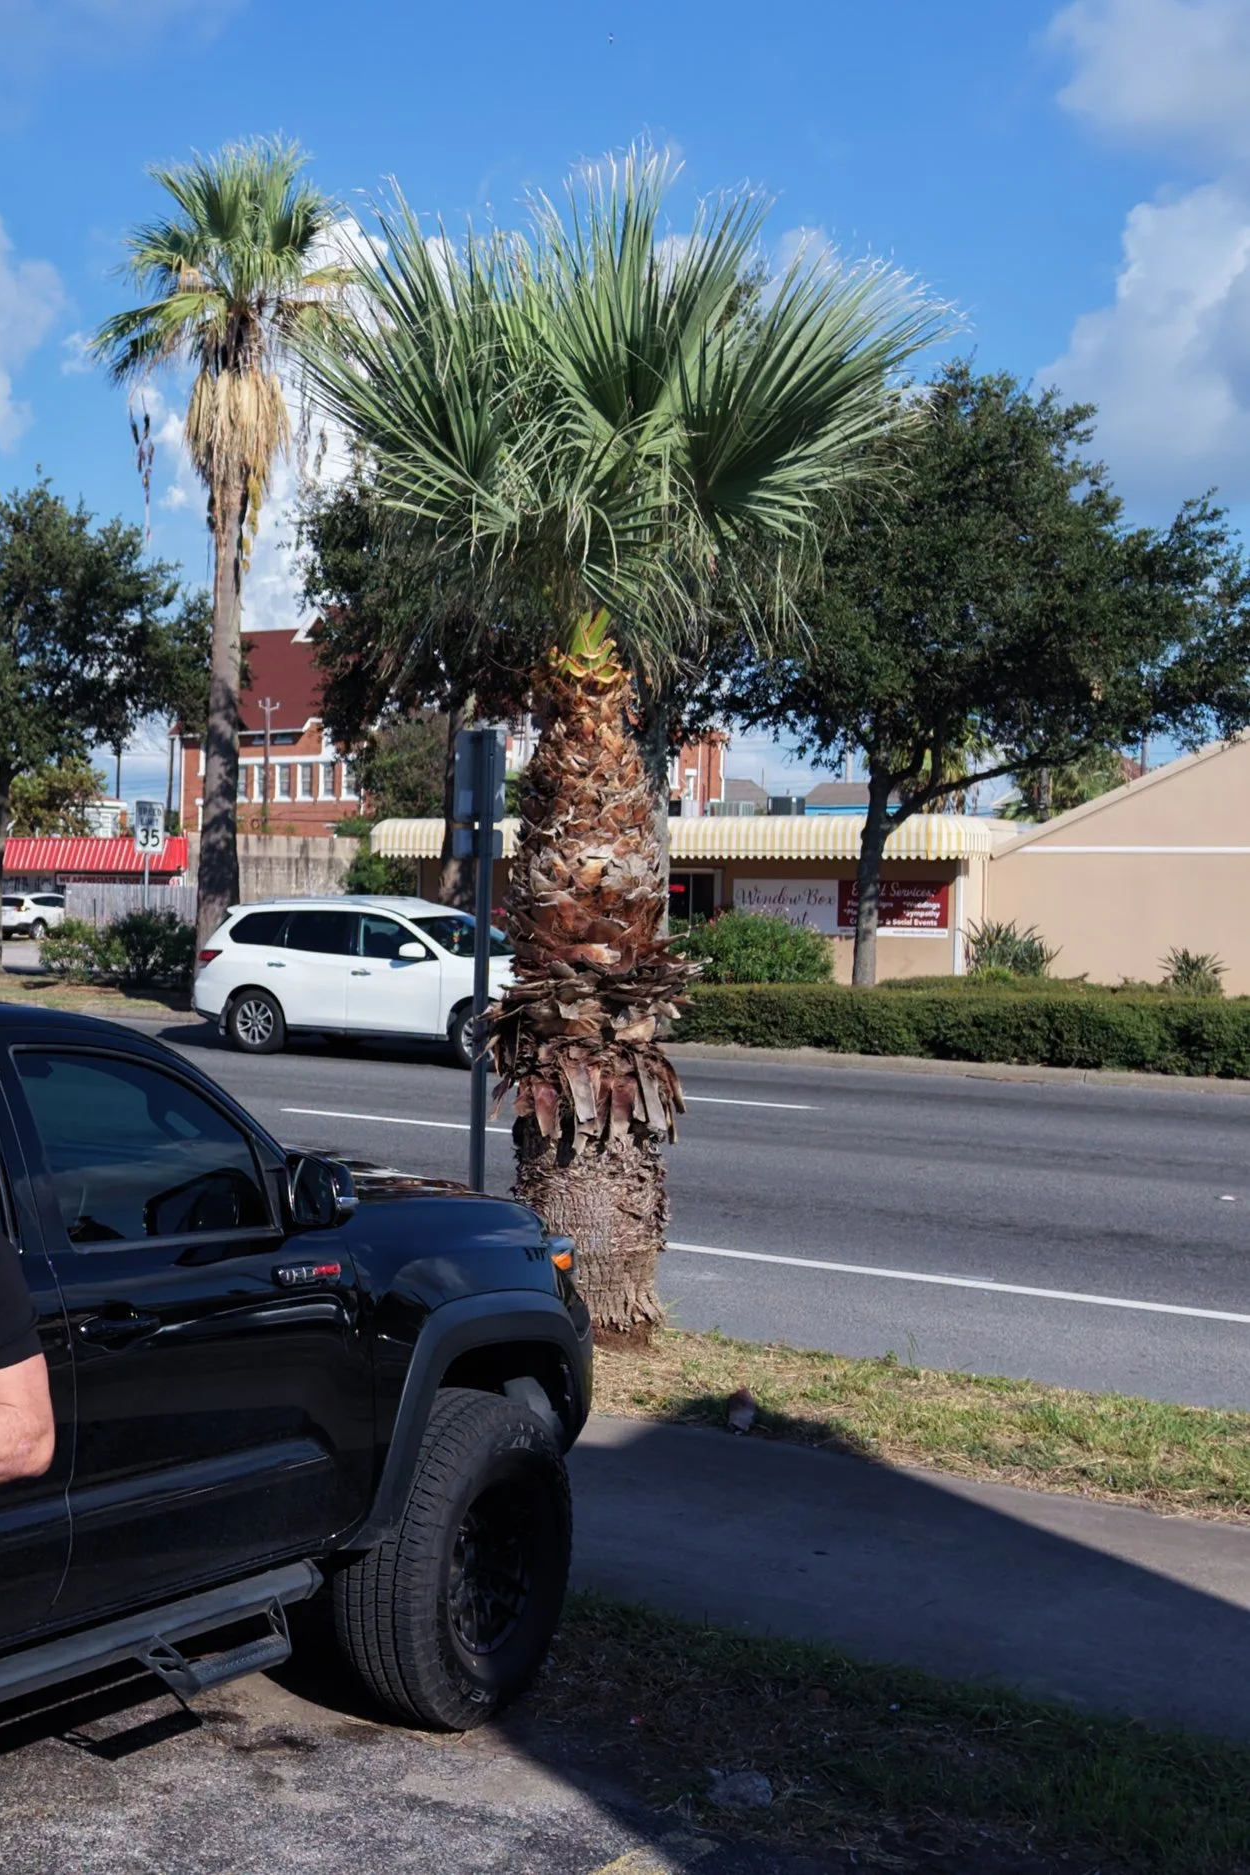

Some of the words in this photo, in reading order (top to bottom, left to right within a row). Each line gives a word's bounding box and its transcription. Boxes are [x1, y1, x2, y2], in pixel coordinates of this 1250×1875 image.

[139, 806, 162, 816] SPEED
[139, 828, 160, 847] 35
[59, 876, 70, 884] WE
[72, 876, 116, 884] APPRECIATE
[119, 876, 142, 884] YOUR
[735, 884, 802, 906] Window
[803, 888, 836, 907] Box
[889, 882, 936, 898] Services:
[892, 918, 912, 926] Social
[913, 919, 937, 927] Events
